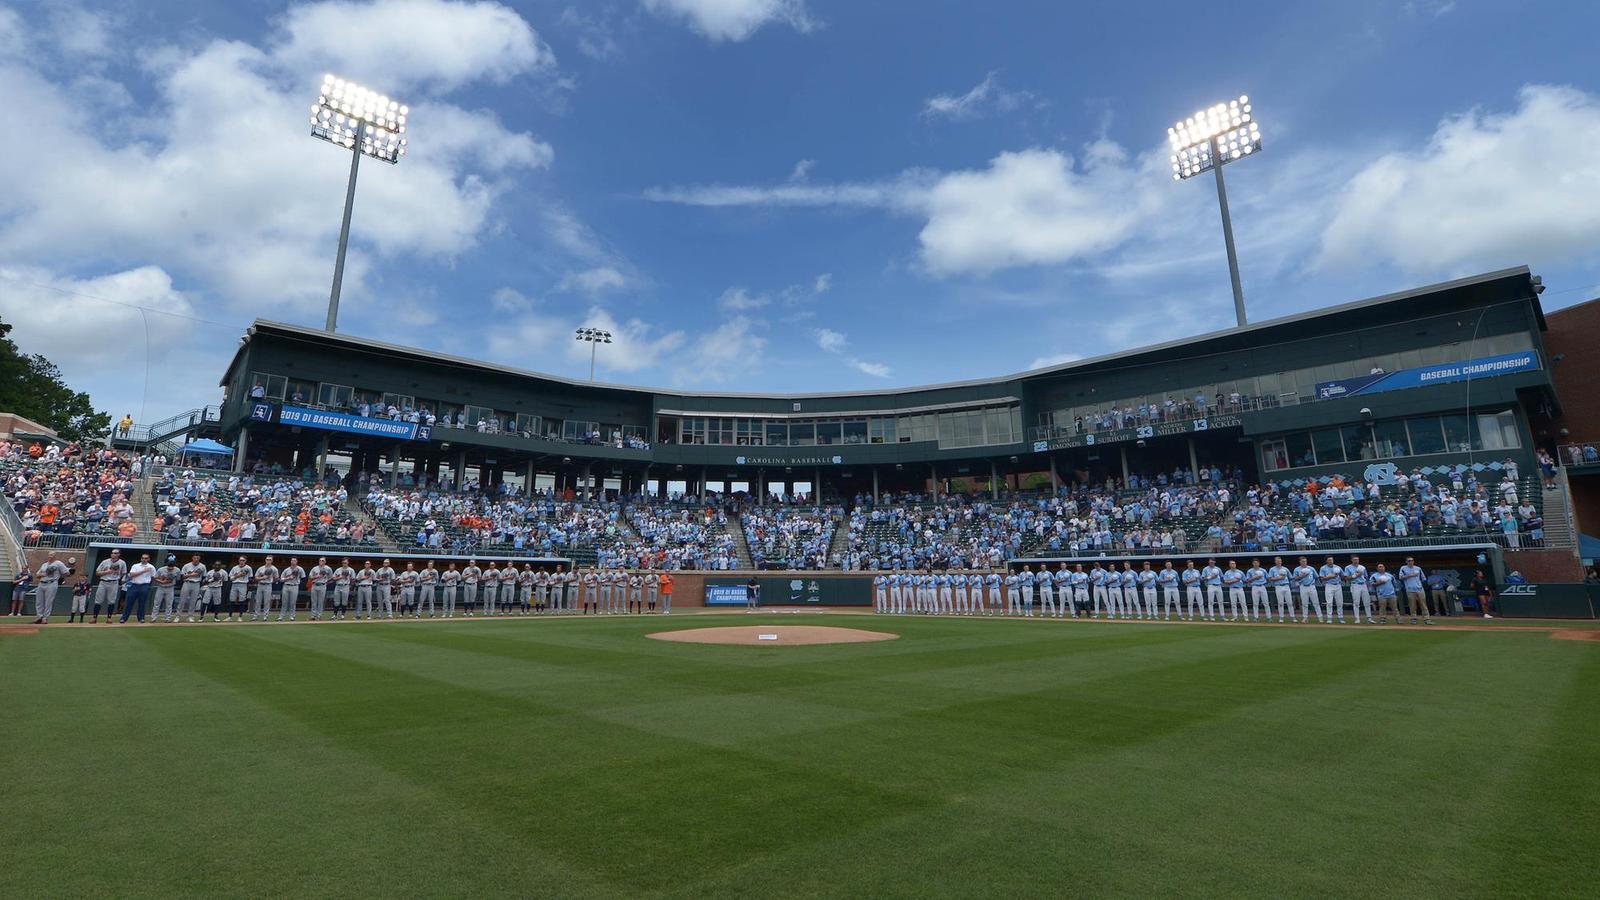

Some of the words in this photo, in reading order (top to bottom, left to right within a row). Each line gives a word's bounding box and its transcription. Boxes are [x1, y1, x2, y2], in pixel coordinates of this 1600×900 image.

[1421, 368, 1460, 380] BASEBALL
[1462, 357, 1530, 374] CHAMPIONSHIP
[280, 410, 300, 421] 2019
[302, 413, 311, 422] DI
[313, 415, 351, 427] BASEBALL
[353, 420, 409, 434] CHAMPIONSHIP
[1193, 419, 1208, 432] 13
[1209, 418, 1242, 430] ACKLEY
[1136, 426, 1153, 439] 33
[1157, 426, 1187, 436] MILLER
[1503, 584, 1537, 593] ACC
